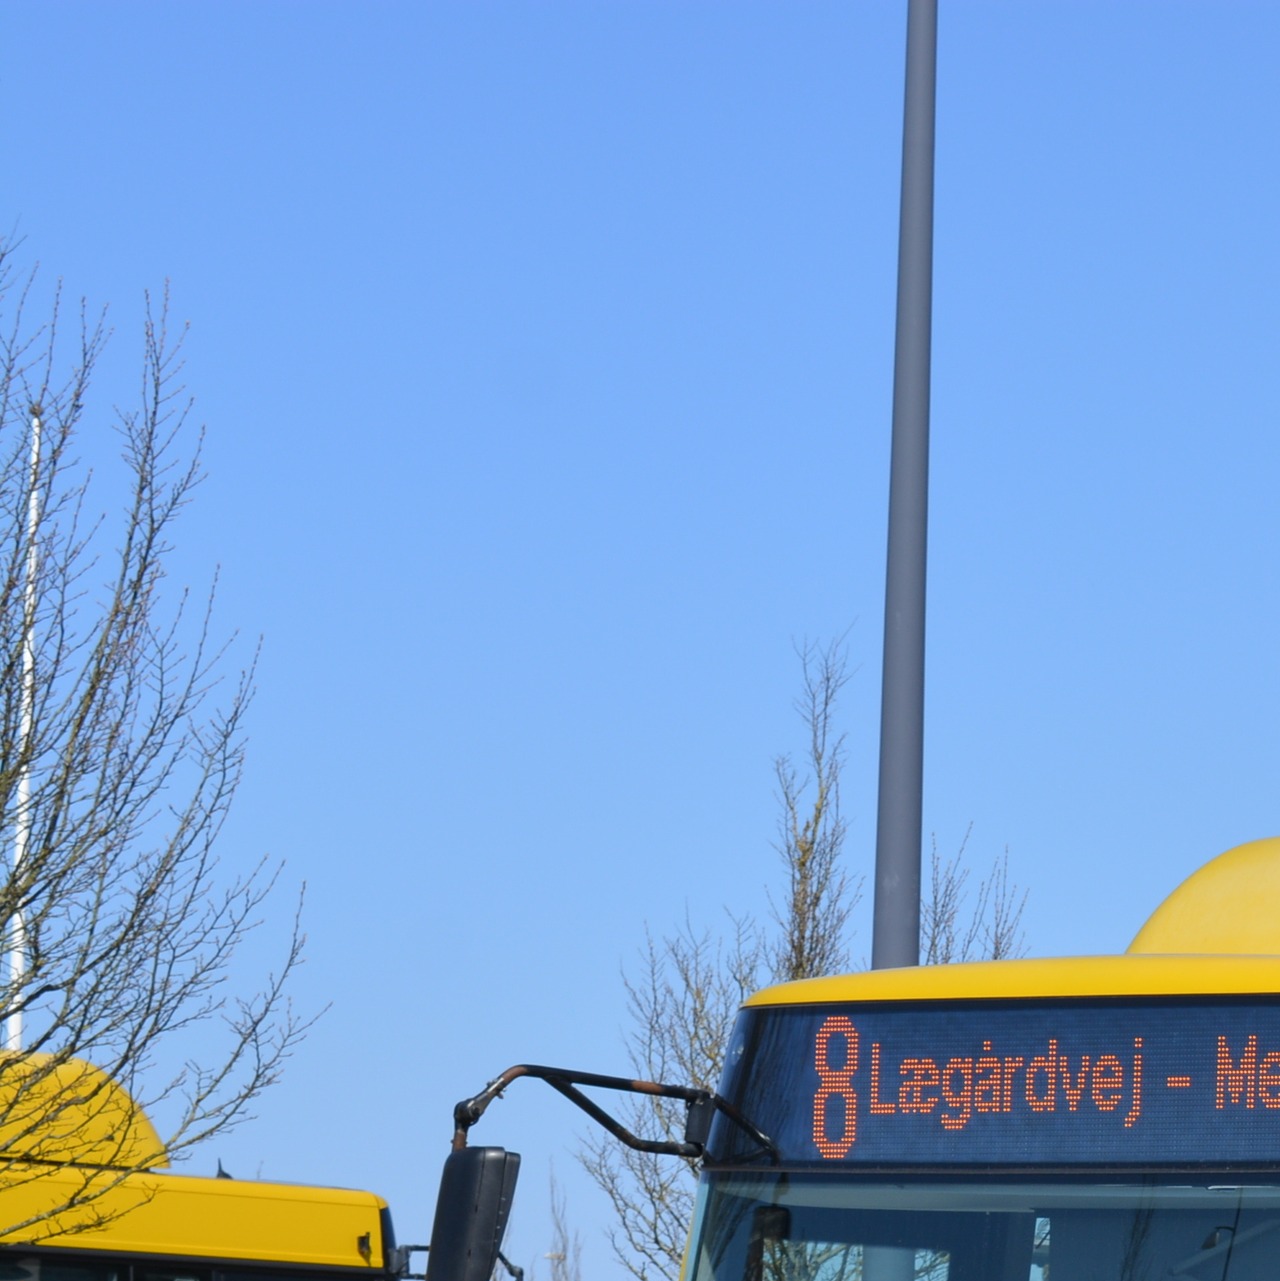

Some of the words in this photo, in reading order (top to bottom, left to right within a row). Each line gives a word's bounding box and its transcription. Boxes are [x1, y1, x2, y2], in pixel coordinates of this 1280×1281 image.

[812, 1016, 859, 1159] 8
[869, 1037, 1142, 1129] Lægårdvej
[1166, 1075, 1191, 1088] -
